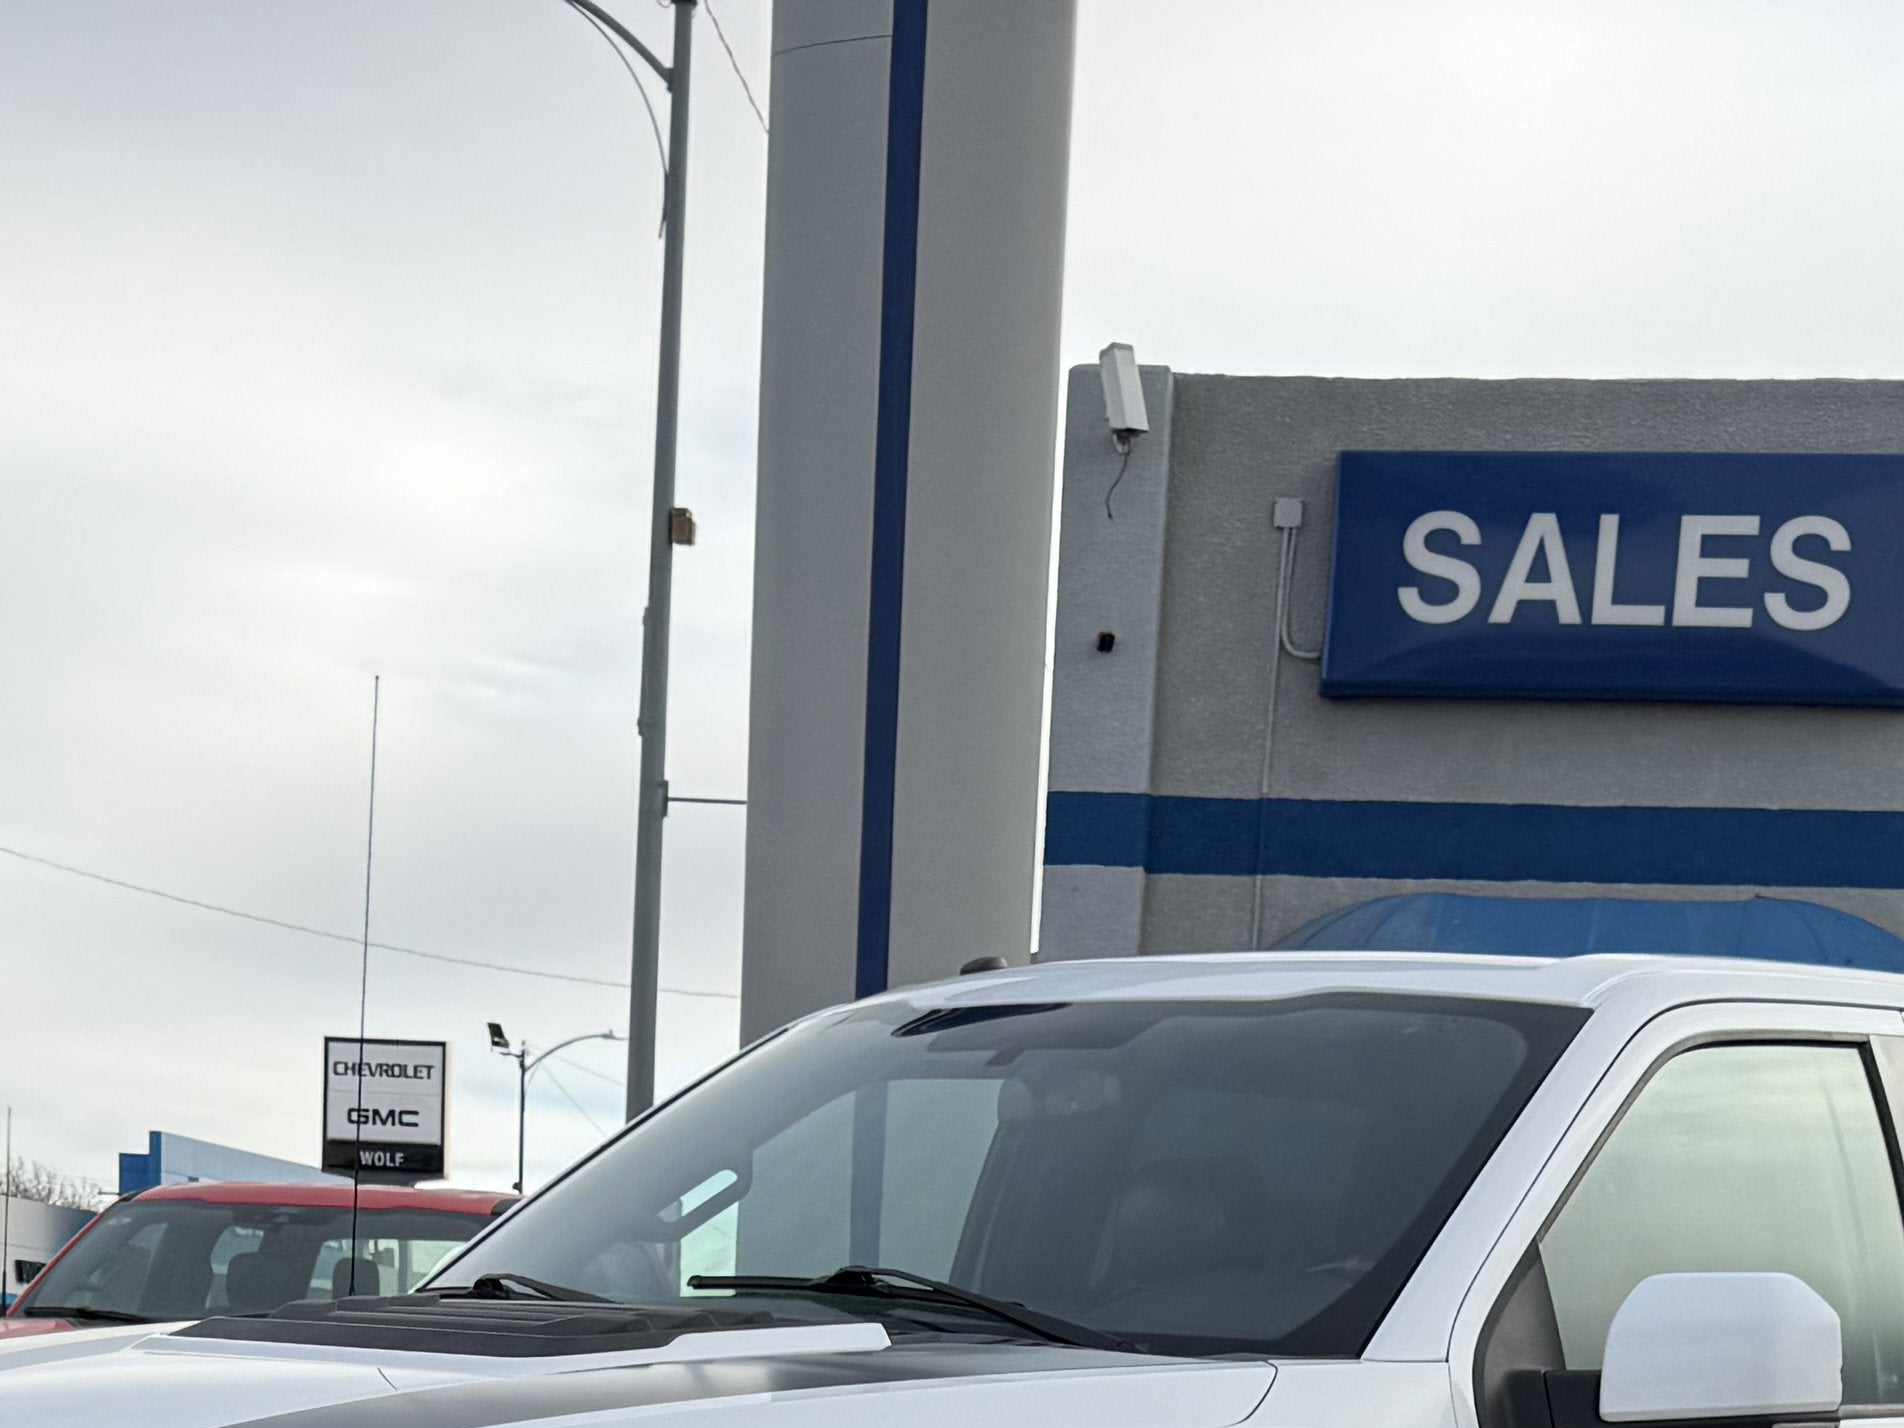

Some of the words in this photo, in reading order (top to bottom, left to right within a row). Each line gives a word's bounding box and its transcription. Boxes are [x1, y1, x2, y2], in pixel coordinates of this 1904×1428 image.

[1397, 511, 1852, 631] SALES
[332, 1060, 435, 1080] CHEVROLET
[346, 1107, 420, 1127] GMC
[359, 1149, 405, 1167] WOLF
